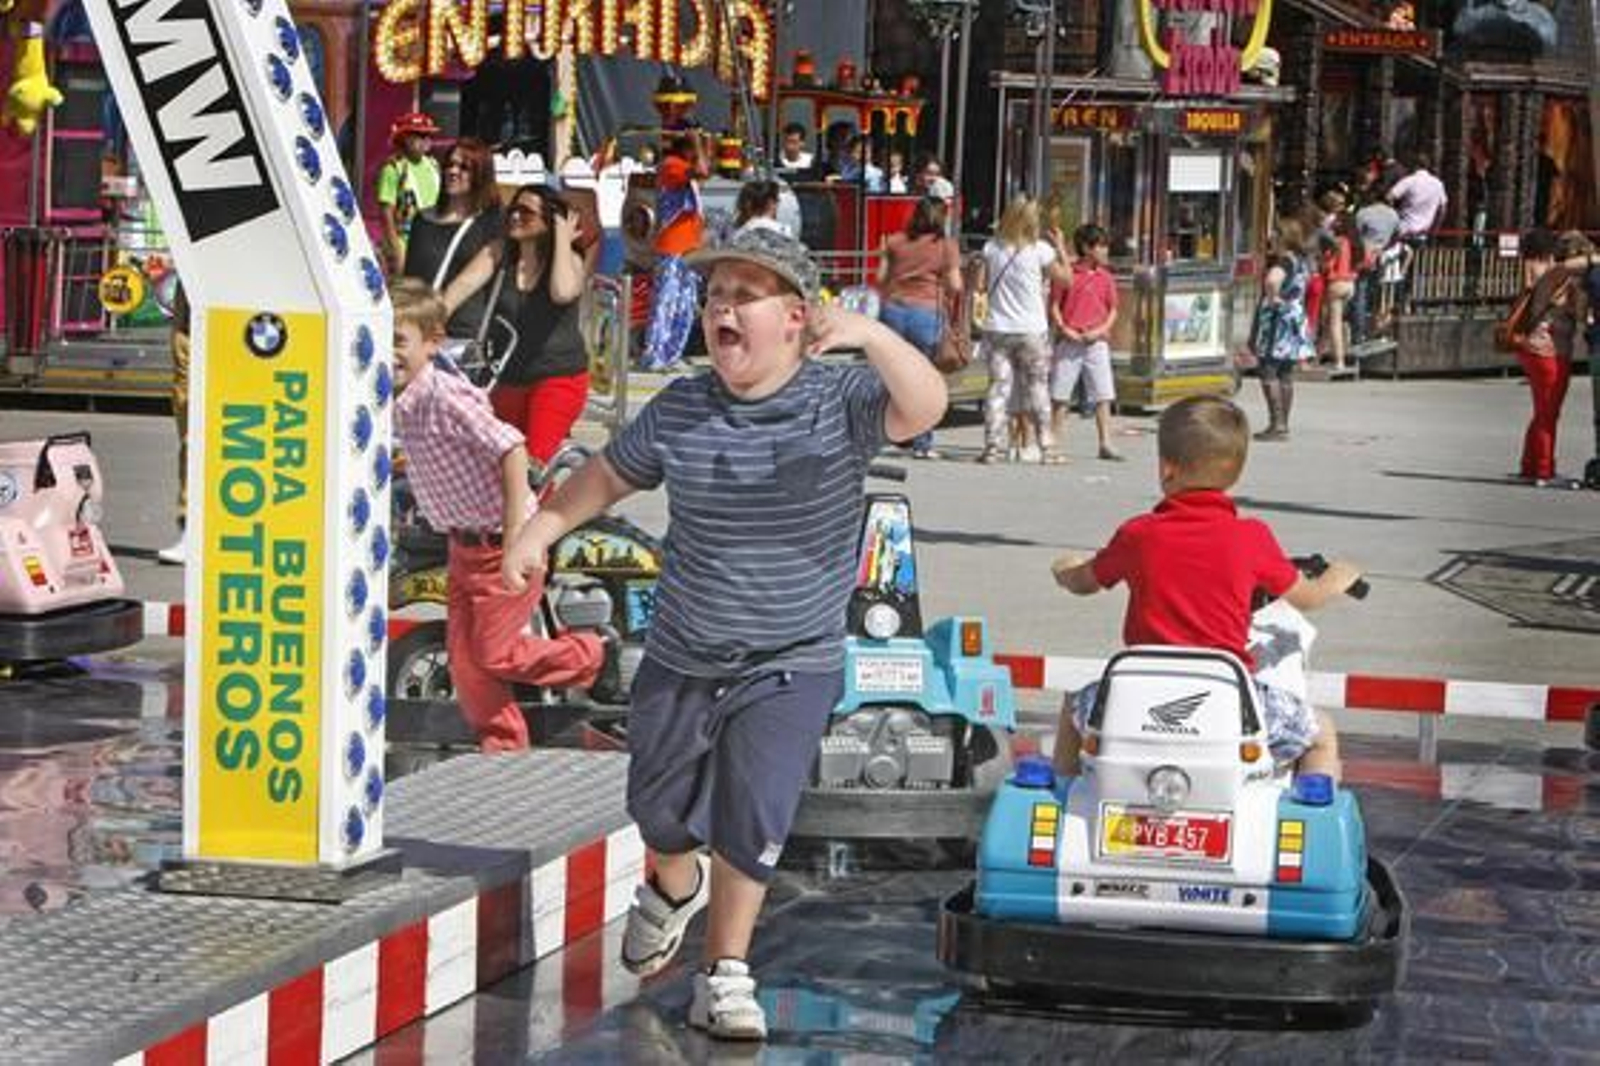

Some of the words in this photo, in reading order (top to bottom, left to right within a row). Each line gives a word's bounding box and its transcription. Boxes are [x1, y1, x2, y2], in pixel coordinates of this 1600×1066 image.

[273, 370, 309, 505] PARA
[215, 404, 266, 771] MOTEROS
[267, 539, 306, 803] BUENOS
[1173, 825, 1209, 850] 457
